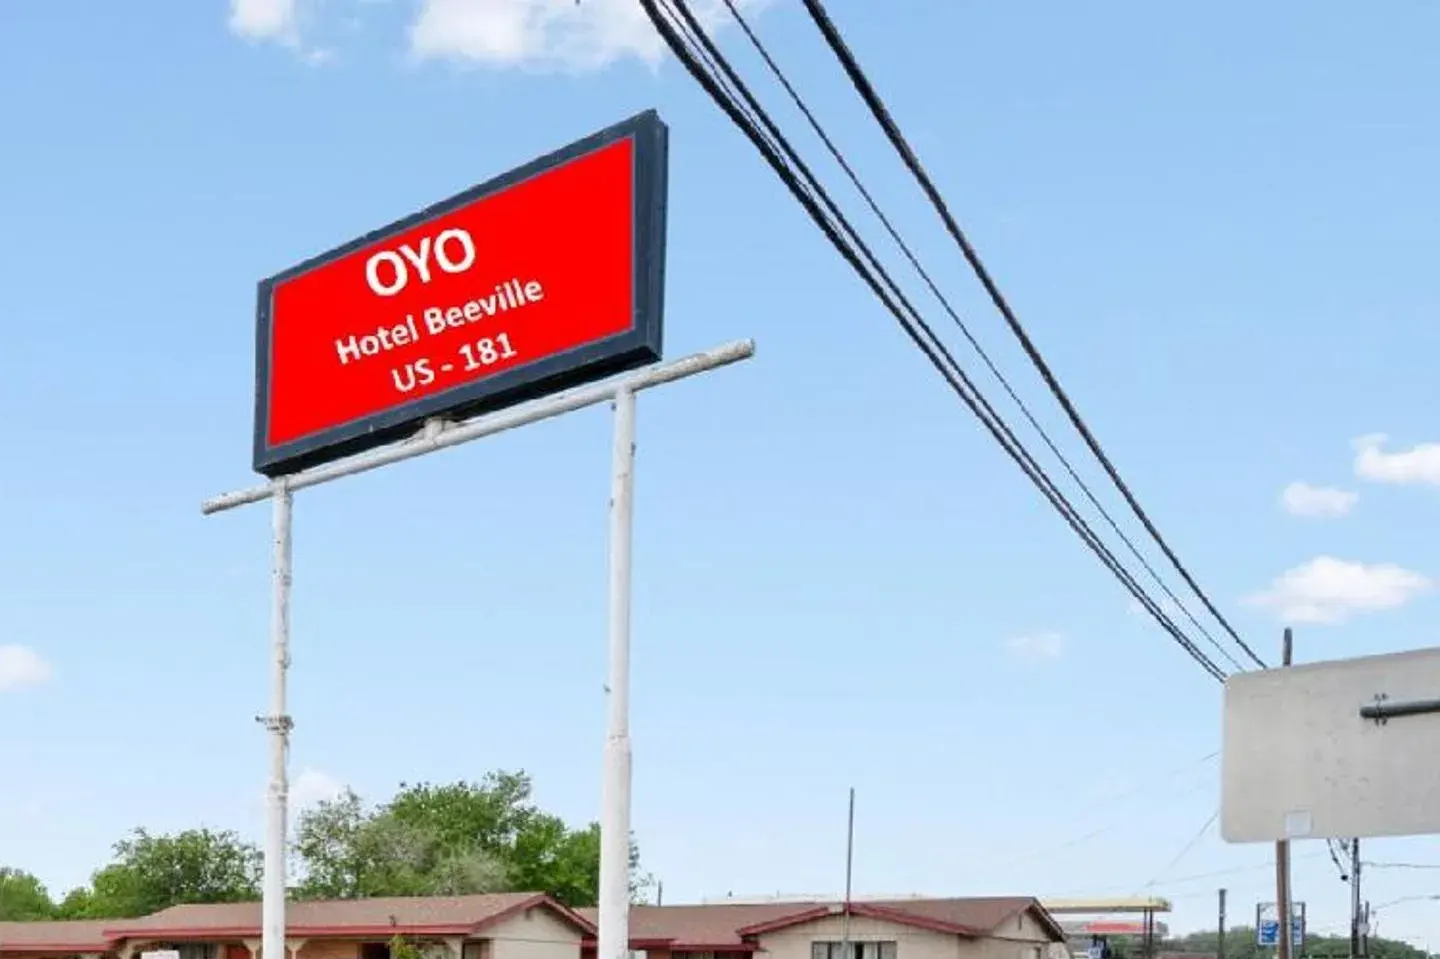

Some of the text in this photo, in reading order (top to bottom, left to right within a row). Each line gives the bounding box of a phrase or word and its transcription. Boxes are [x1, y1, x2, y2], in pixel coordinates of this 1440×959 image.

[365, 228, 476, 296] OYO
[335, 278, 544, 365] Hotel Beeville
[391, 358, 435, 392] US
[459, 332, 517, 371] 181
